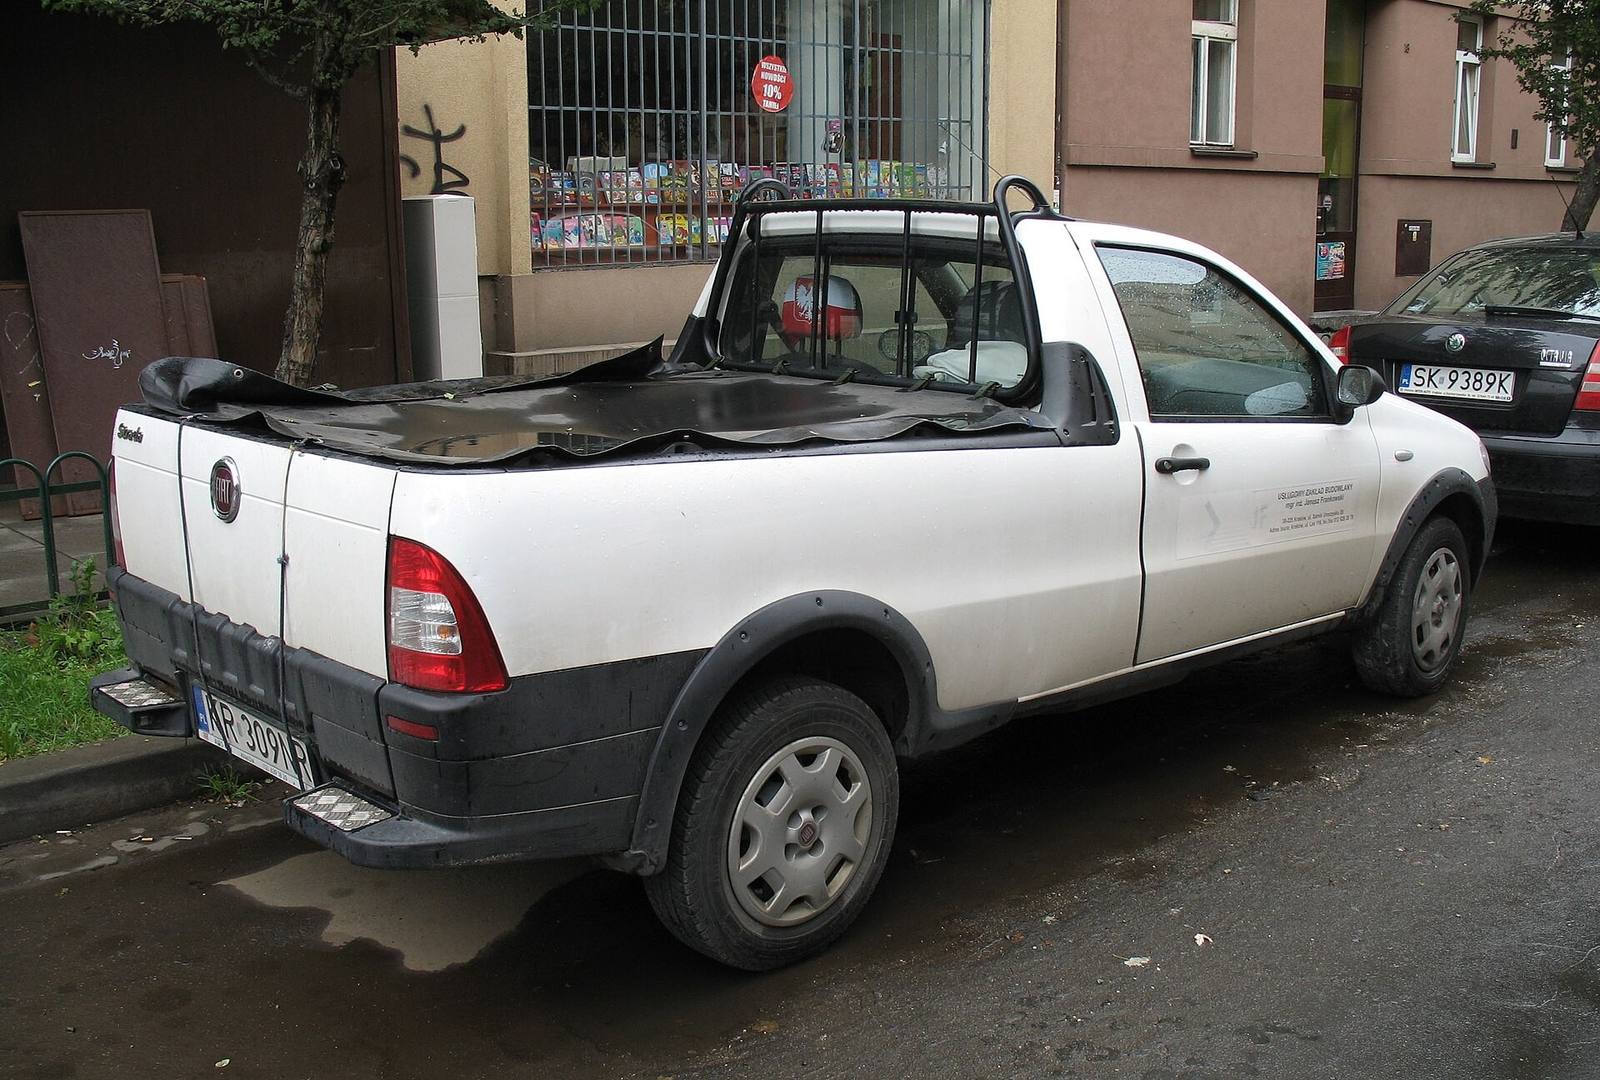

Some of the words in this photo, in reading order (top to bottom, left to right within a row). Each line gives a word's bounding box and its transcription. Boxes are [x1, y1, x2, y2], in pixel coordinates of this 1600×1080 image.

[761, 62, 787, 73] WSZYSTKI
[763, 84, 782, 100] 10%
[1540, 348, 1573, 363] OCTAVIA
[1413, 367, 1441, 388] SK
[1447, 369, 1511, 394] 9389K
[215, 476, 231, 504] FIAT
[205, 694, 239, 744] KR
[240, 713, 313, 783] 309NR
